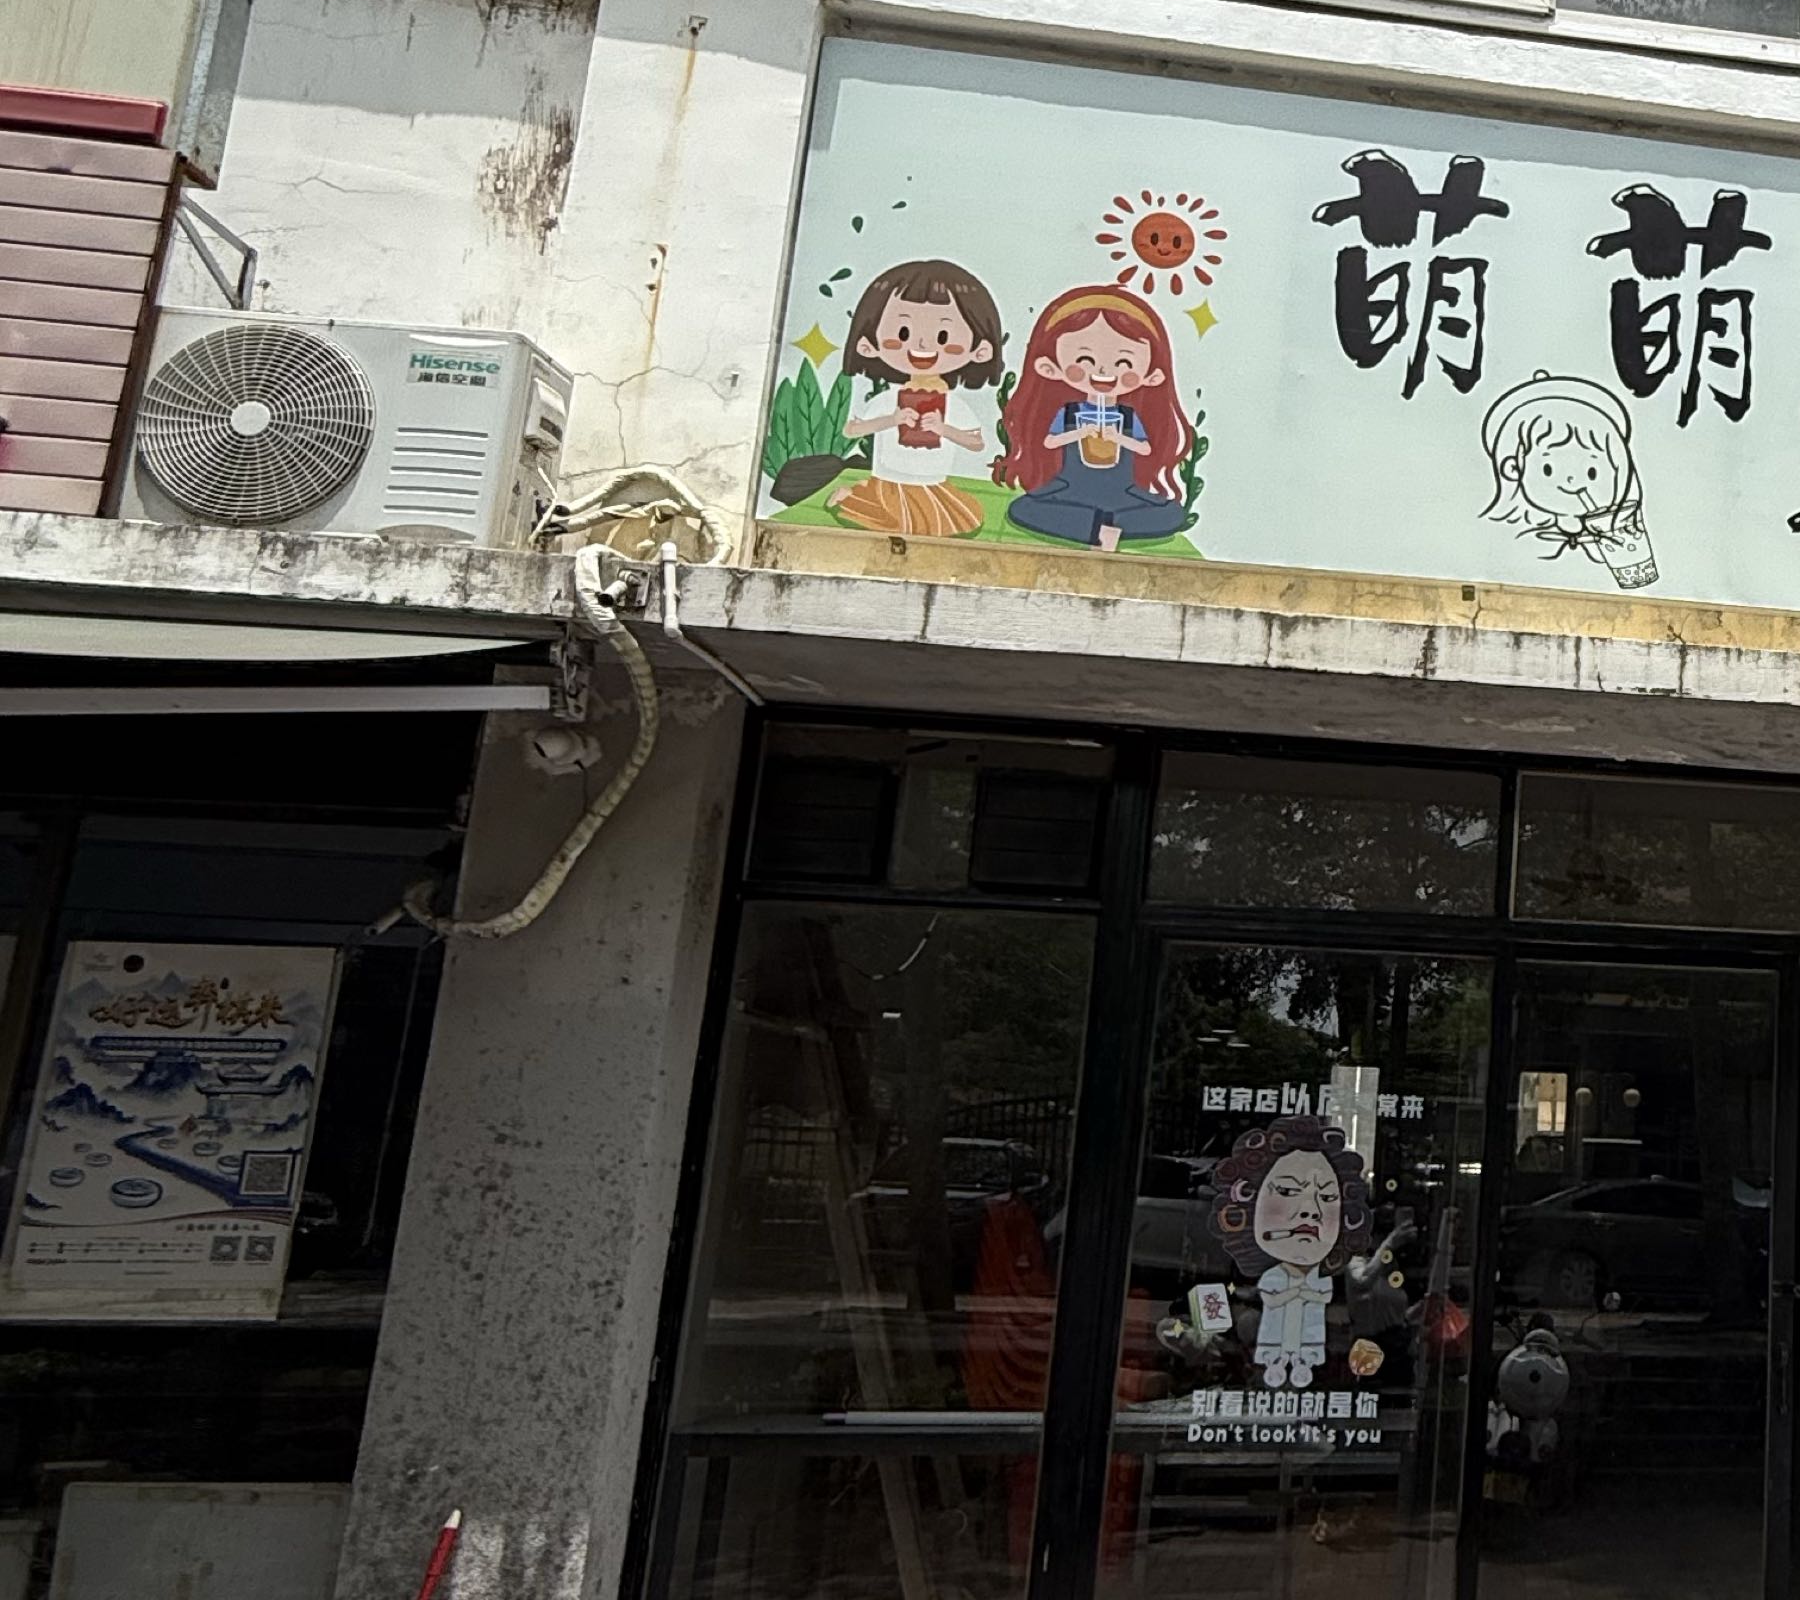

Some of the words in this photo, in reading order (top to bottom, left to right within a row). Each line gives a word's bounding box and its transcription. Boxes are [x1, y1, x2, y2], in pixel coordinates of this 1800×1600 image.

[409, 353, 501, 374] Hisense
[1190, 1389, 1380, 1419] 别看说的就是你
[1187, 1423, 1245, 1443] Don't
[1252, 1423, 1297, 1443] look
[1344, 1428, 1382, 1447] you
